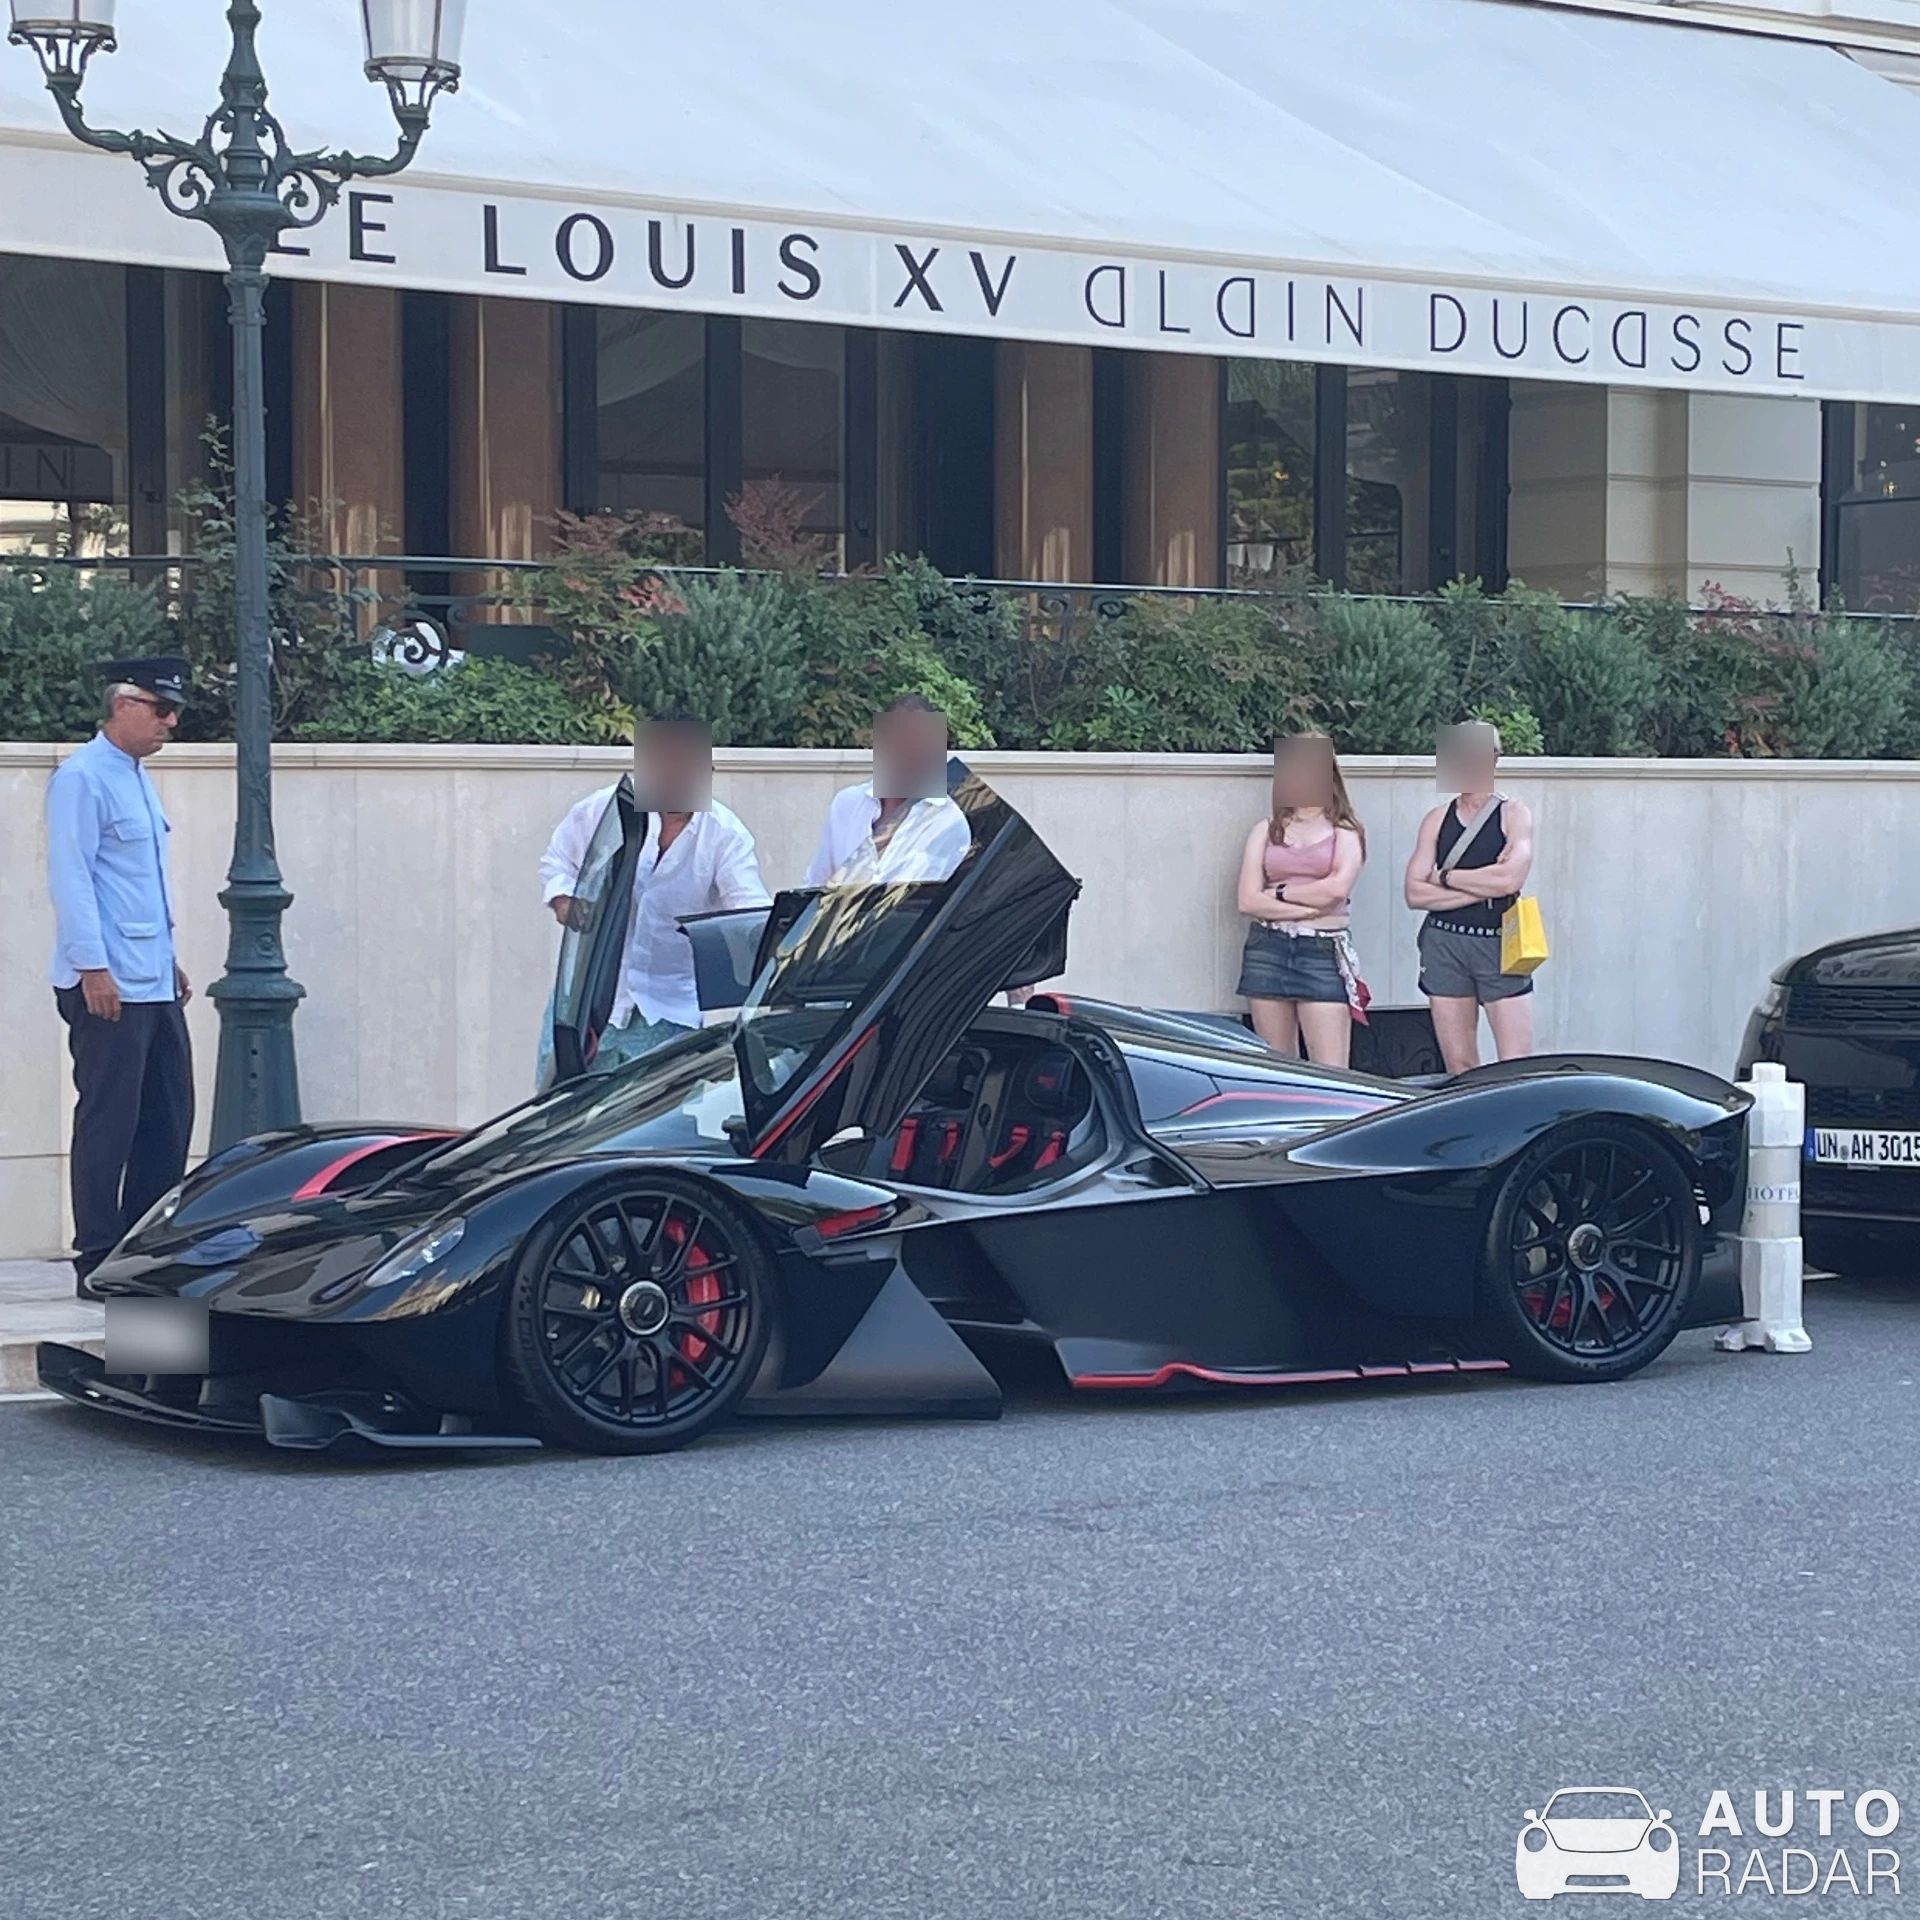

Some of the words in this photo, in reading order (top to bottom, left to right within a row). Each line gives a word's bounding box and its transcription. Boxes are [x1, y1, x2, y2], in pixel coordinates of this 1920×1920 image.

[483, 204, 822, 300] LOUIS
[893, 243, 1018, 318] XV
[1850, 1133, 1874, 1161] AH
